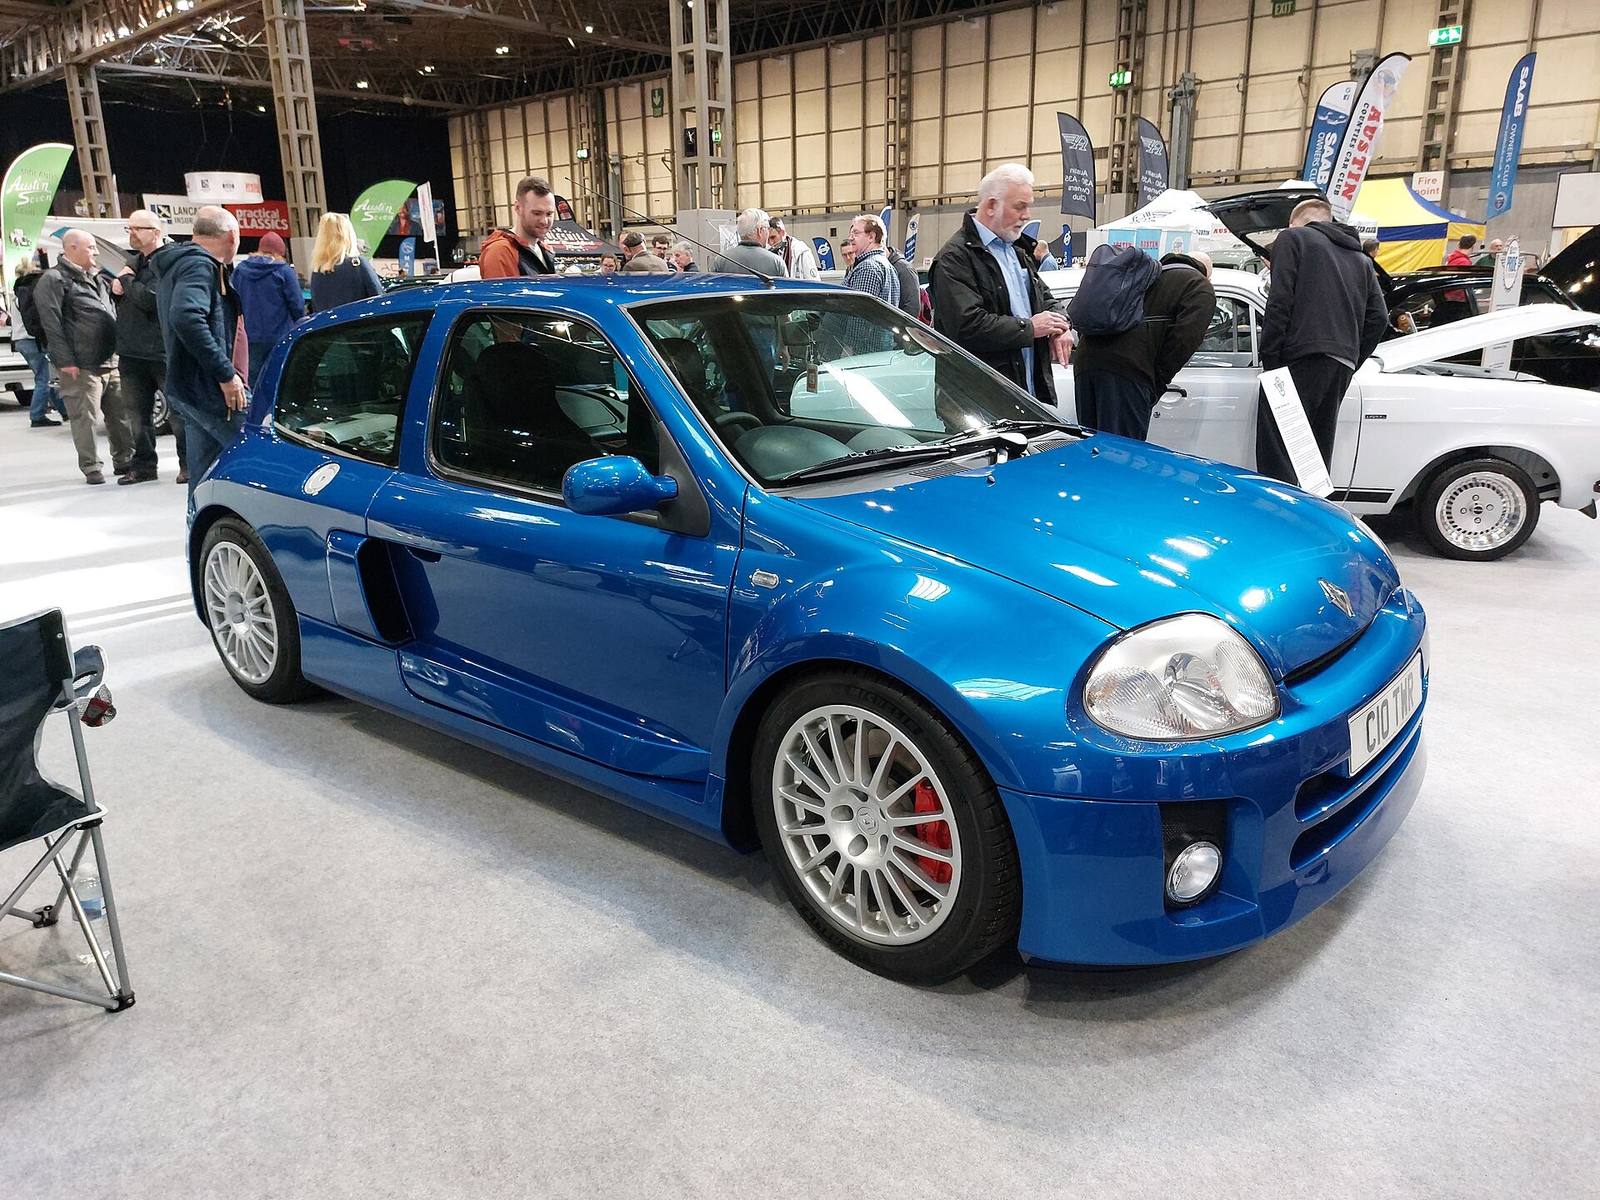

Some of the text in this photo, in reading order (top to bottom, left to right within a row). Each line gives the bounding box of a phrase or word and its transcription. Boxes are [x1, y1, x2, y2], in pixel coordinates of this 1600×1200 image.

[1274, 1, 1294, 16] EXIT
[1513, 66, 1529, 118] SAAB
[1312, 131, 1326, 167] OWNERS
[1333, 102, 1370, 196] COUNTIES CAR CLUB
[1341, 105, 1382, 201] AUSTIN
[1506, 123, 1518, 163] OWNERS
[1317, 132, 1338, 185] SAAB
[6, 175, 49, 195] Austin
[1417, 176, 1438, 185] Fire
[1501, 164, 1510, 187] CLUB
[236, 208, 280, 219] practical
[354, 199, 394, 214] Austin
[238, 218, 289, 230] CLASSICS
[1366, 698, 1390, 754] C10
